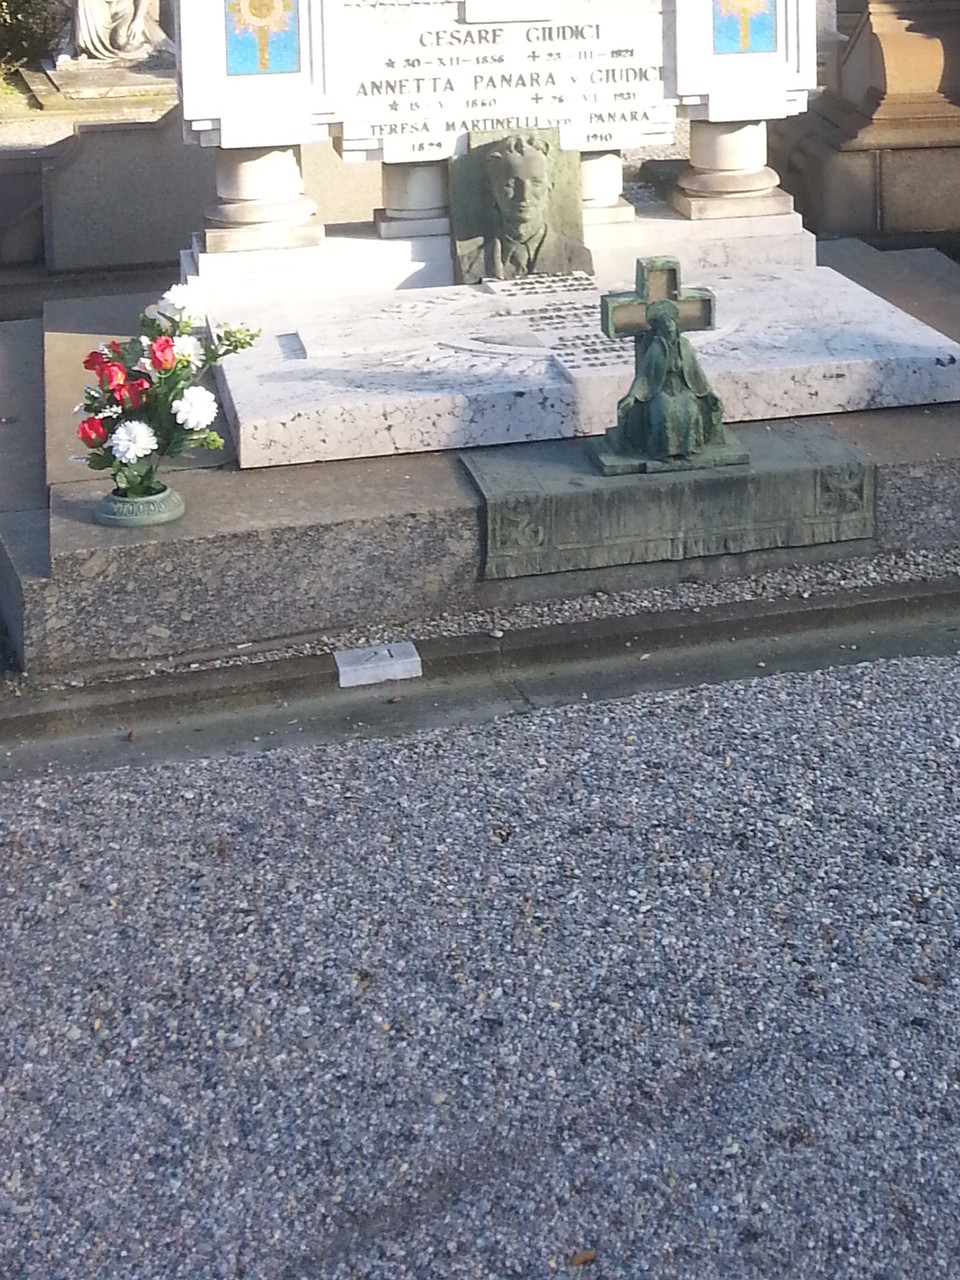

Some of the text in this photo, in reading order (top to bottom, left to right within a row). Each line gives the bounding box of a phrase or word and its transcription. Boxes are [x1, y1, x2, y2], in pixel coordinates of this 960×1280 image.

[419, 24, 600, 47] CESARE GIUDICI
[356, 77, 455, 96] ANNETTA
[473, 72, 556, 91] PANARA
[590, 66, 665, 84] GIUDICI
[369, 121, 430, 137] TERESA
[445, 116, 538, 132] MARTINELLI
[589, 111, 650, 124] PANARA
